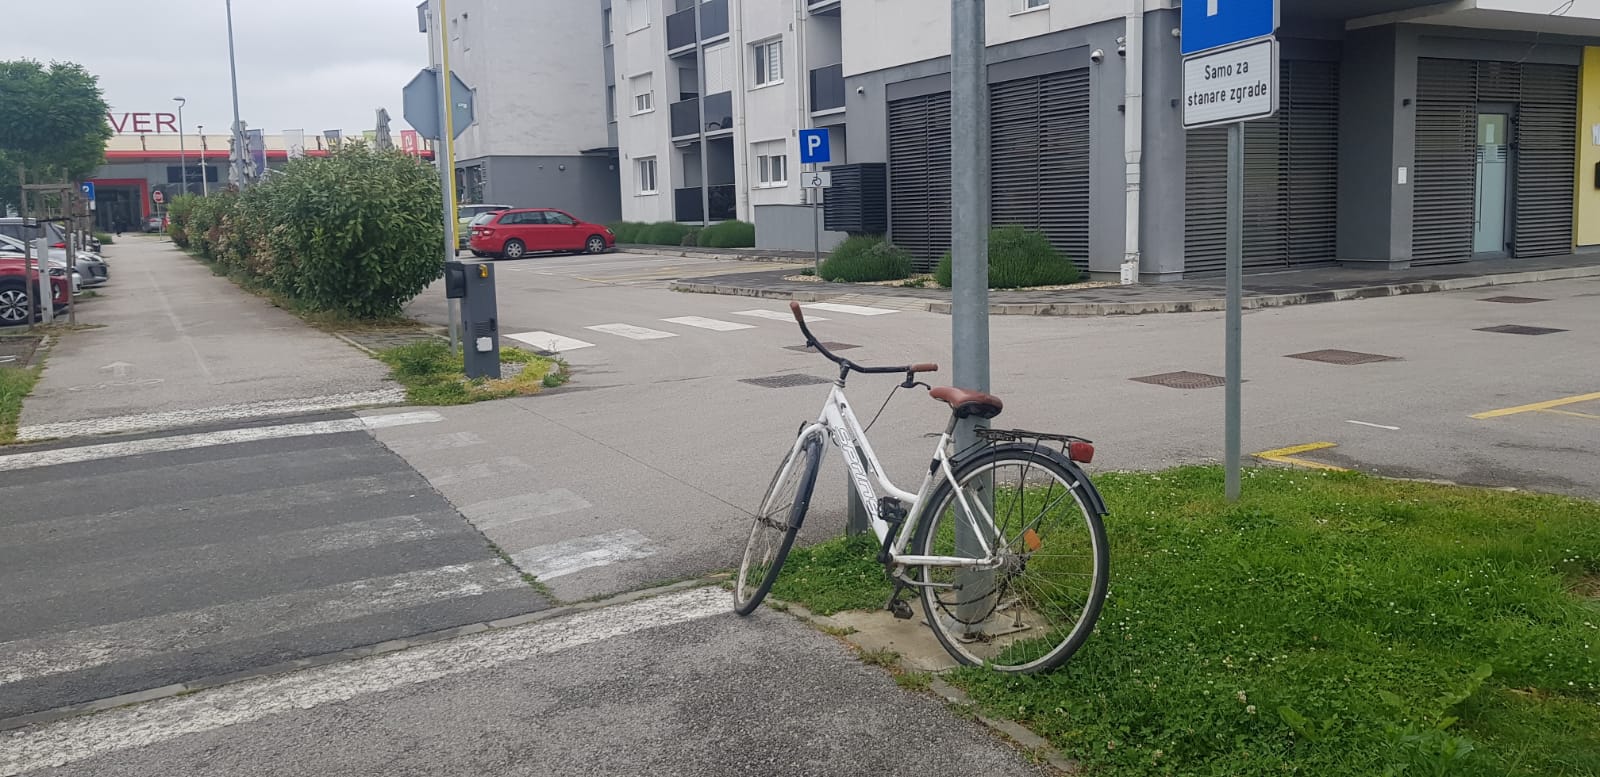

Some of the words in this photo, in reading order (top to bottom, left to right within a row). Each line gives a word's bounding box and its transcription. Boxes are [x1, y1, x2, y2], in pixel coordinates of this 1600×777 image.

[1204, 64, 1232, 80] Samo
[1236, 61, 1249, 74] za
[1187, 91, 1226, 106] stanare
[1230, 80, 1267, 103] zgrade
[807, 135, 821, 156] P
